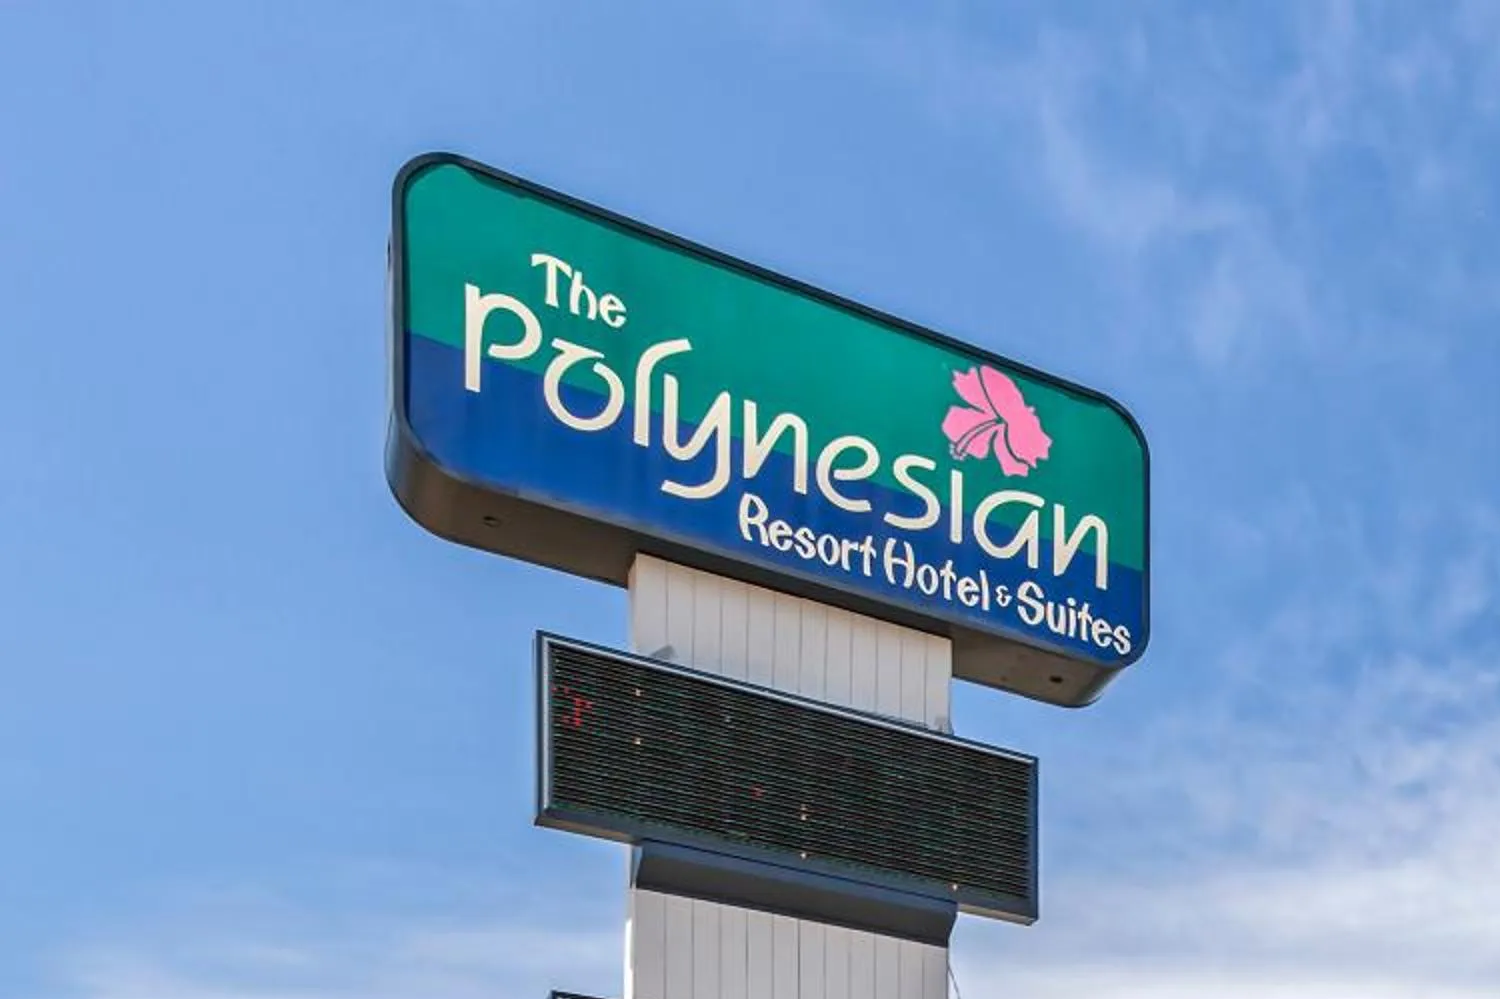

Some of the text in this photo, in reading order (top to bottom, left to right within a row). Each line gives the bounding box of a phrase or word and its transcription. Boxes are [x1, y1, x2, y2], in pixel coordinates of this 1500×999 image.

[531, 253, 627, 328] The
[464, 283, 1109, 591] Polynesian
[738, 493, 1132, 657] Resort Hotel & Suites
